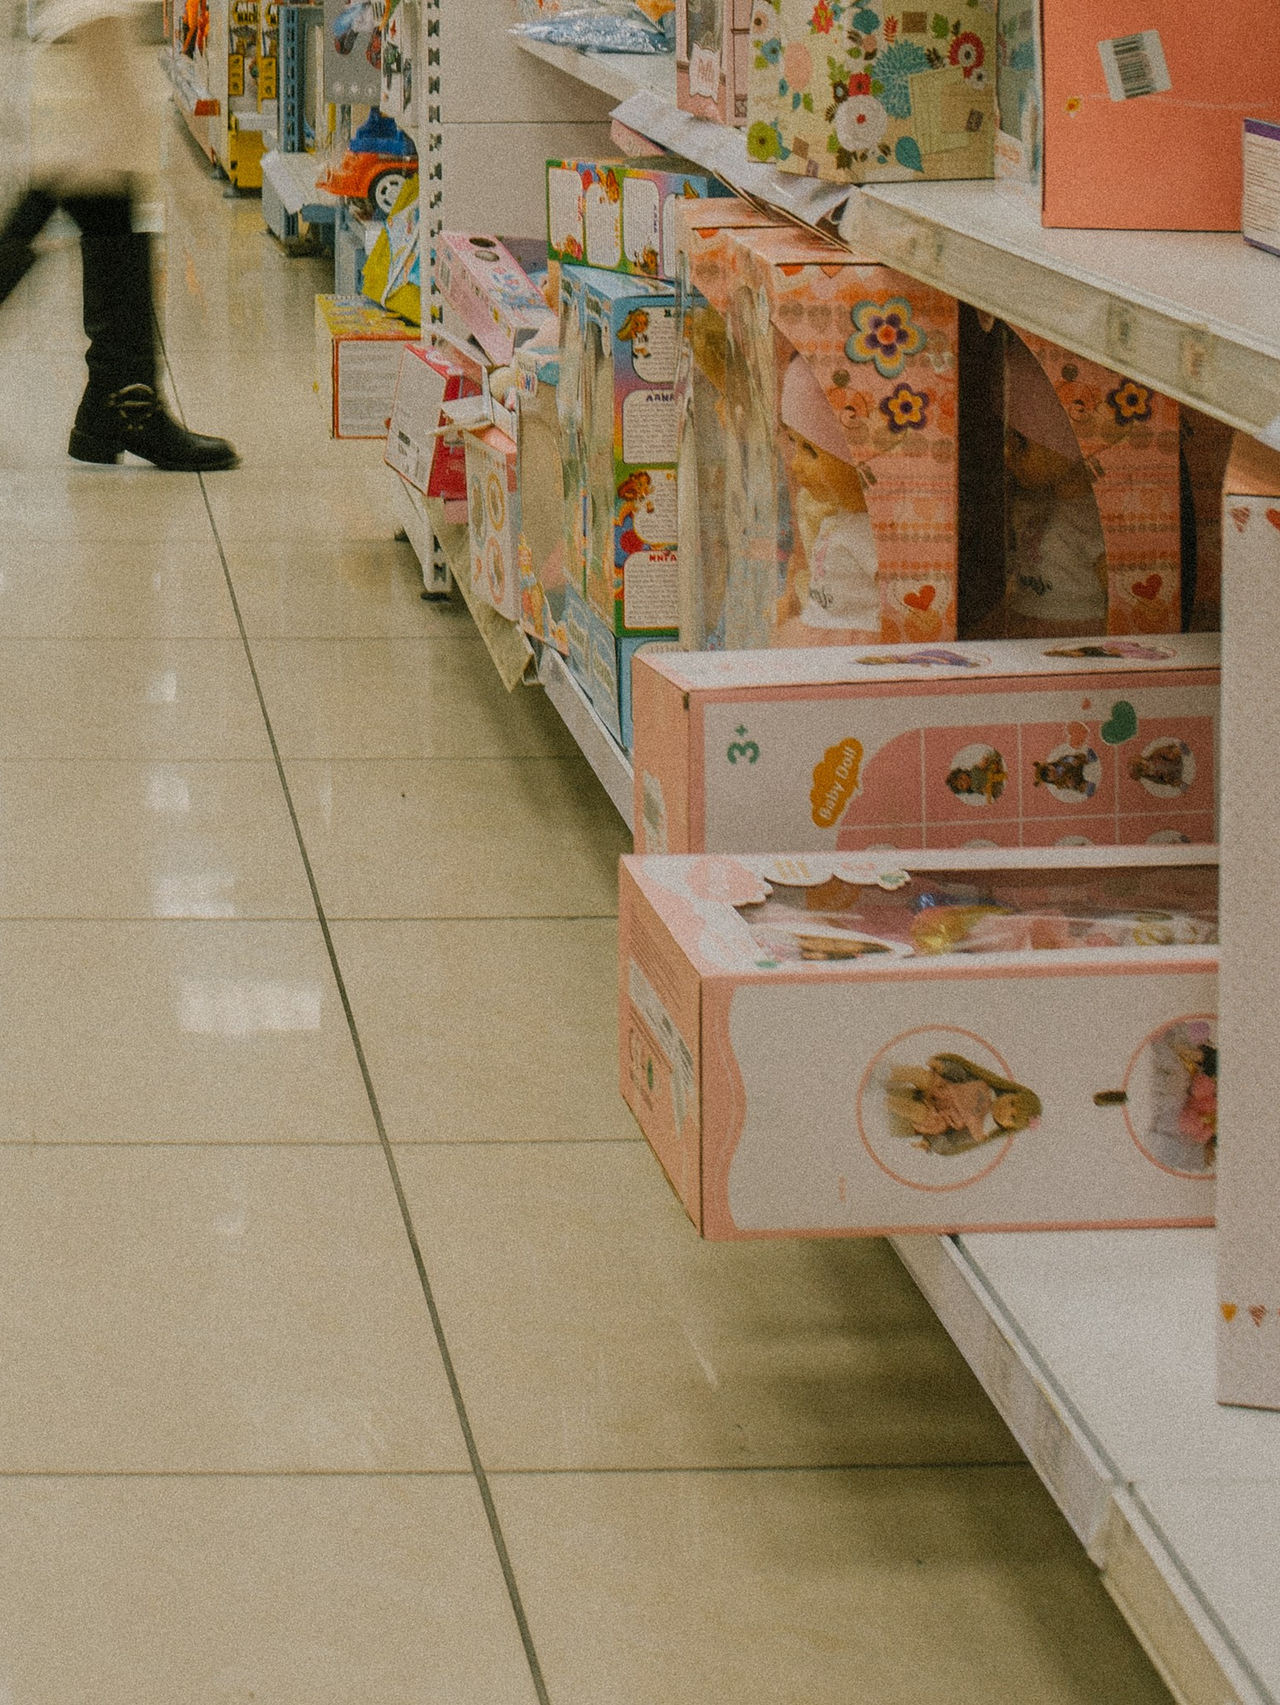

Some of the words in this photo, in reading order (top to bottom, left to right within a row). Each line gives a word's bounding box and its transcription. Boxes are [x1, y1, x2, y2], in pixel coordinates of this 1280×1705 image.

[726, 724, 760, 765] 3+
[819, 780, 846, 820] Baby
[835, 746, 857, 780] Doll
